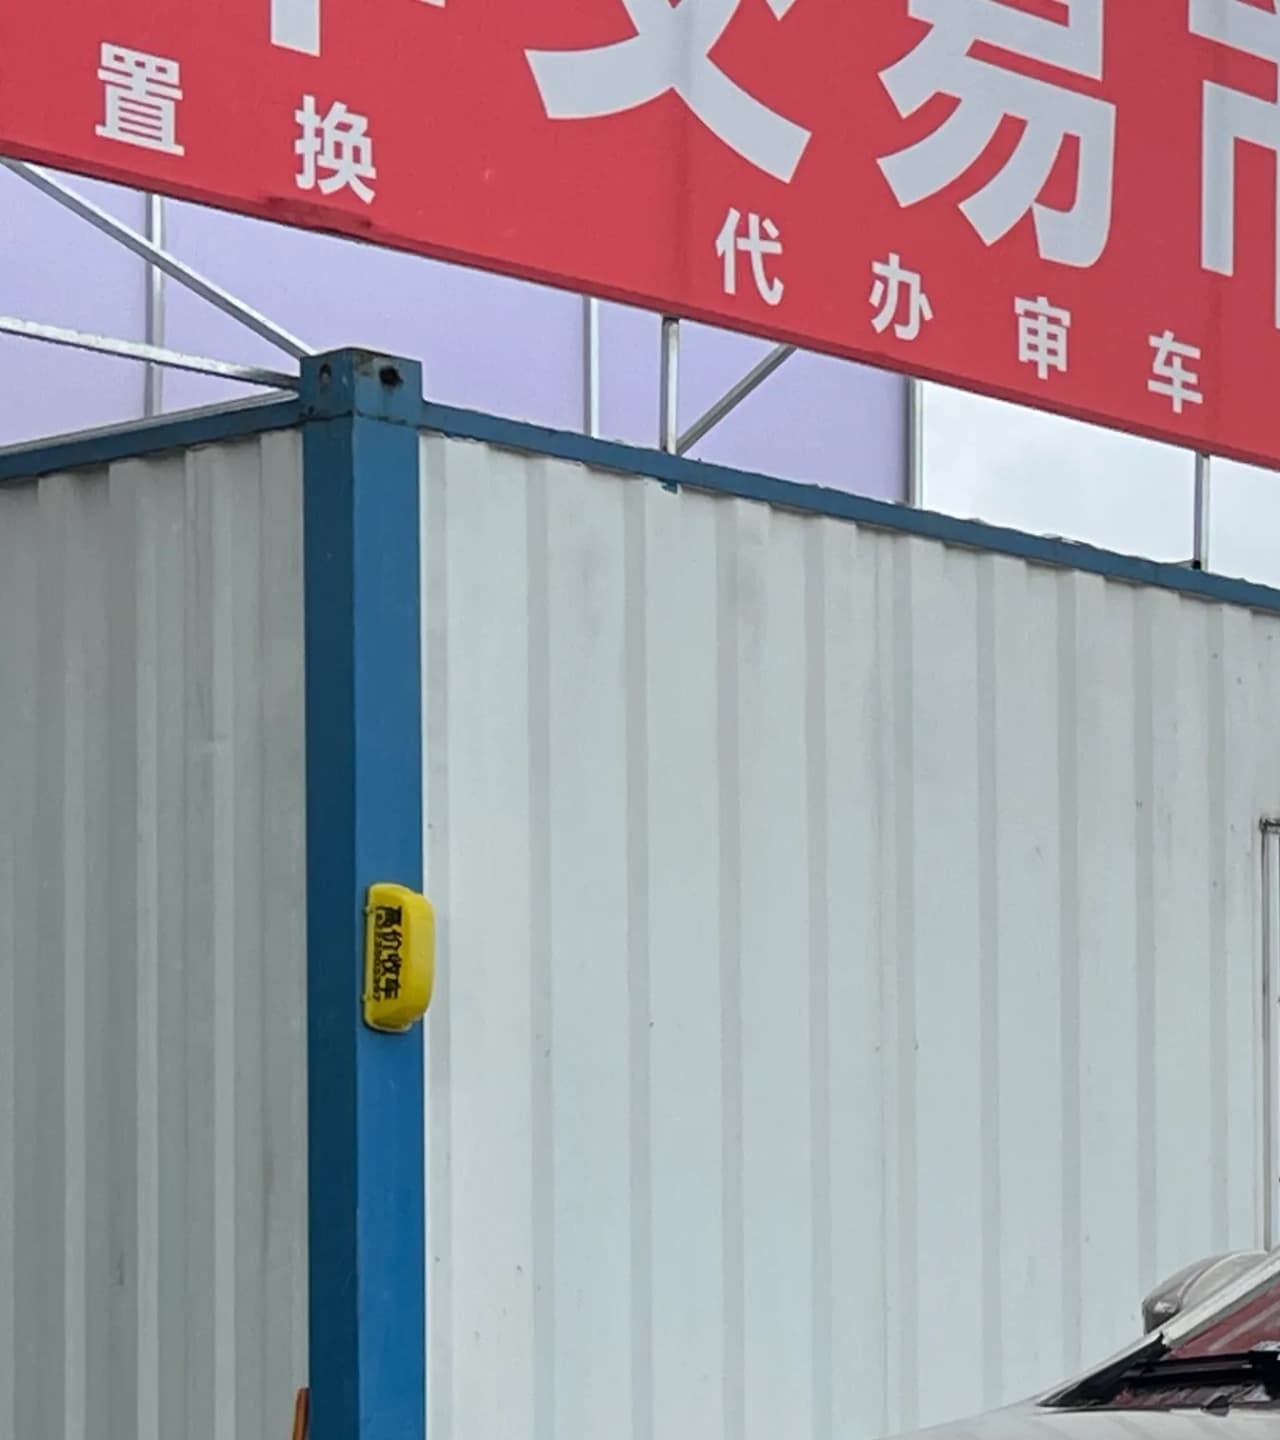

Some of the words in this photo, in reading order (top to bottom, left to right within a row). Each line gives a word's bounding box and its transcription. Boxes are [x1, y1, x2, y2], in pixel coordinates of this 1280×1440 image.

[95, 41, 378, 205] 置换
[715, 207, 1203, 414] 代办审车
